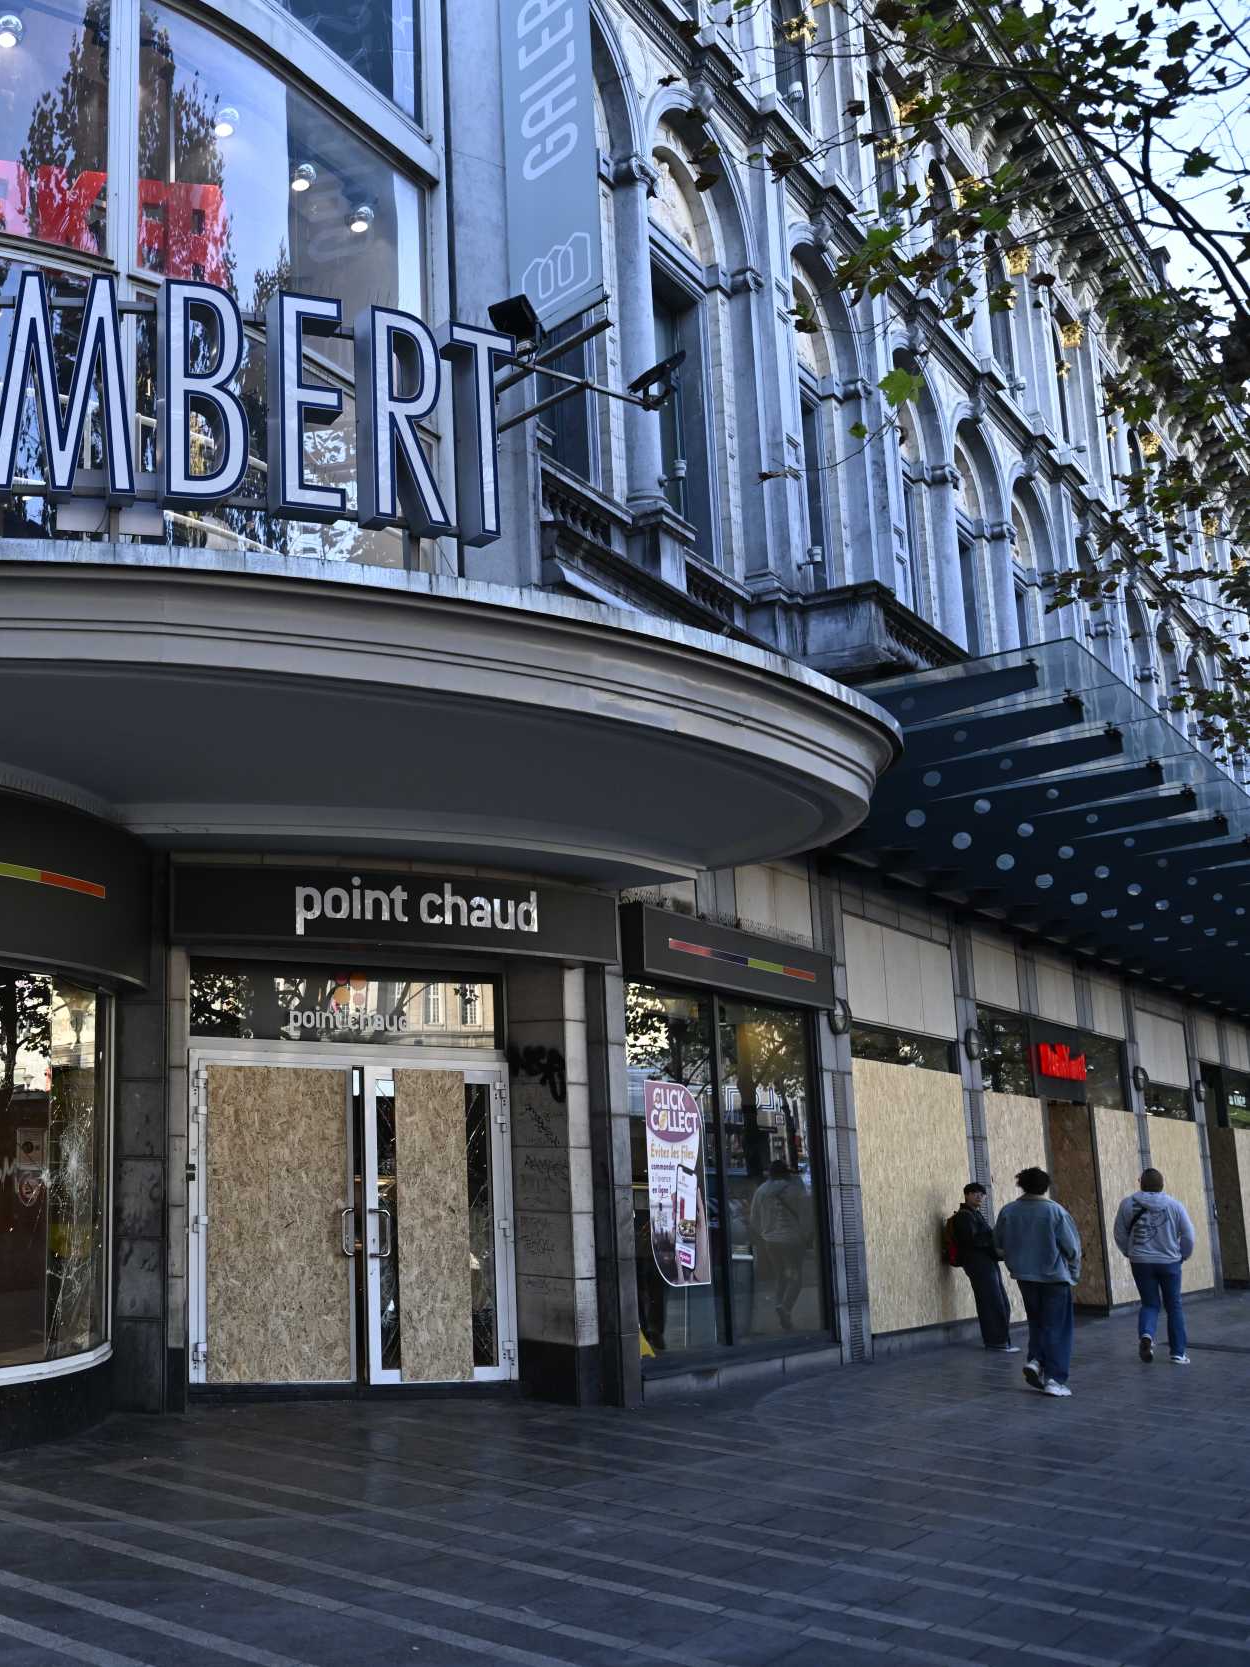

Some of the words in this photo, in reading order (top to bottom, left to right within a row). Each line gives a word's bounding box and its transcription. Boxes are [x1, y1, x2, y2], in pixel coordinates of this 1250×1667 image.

[295, 876, 409, 935] point
[419, 883, 538, 933] chaud
[653, 1087, 686, 1111] CLICK
[650, 1109, 698, 1134] COLLECT
